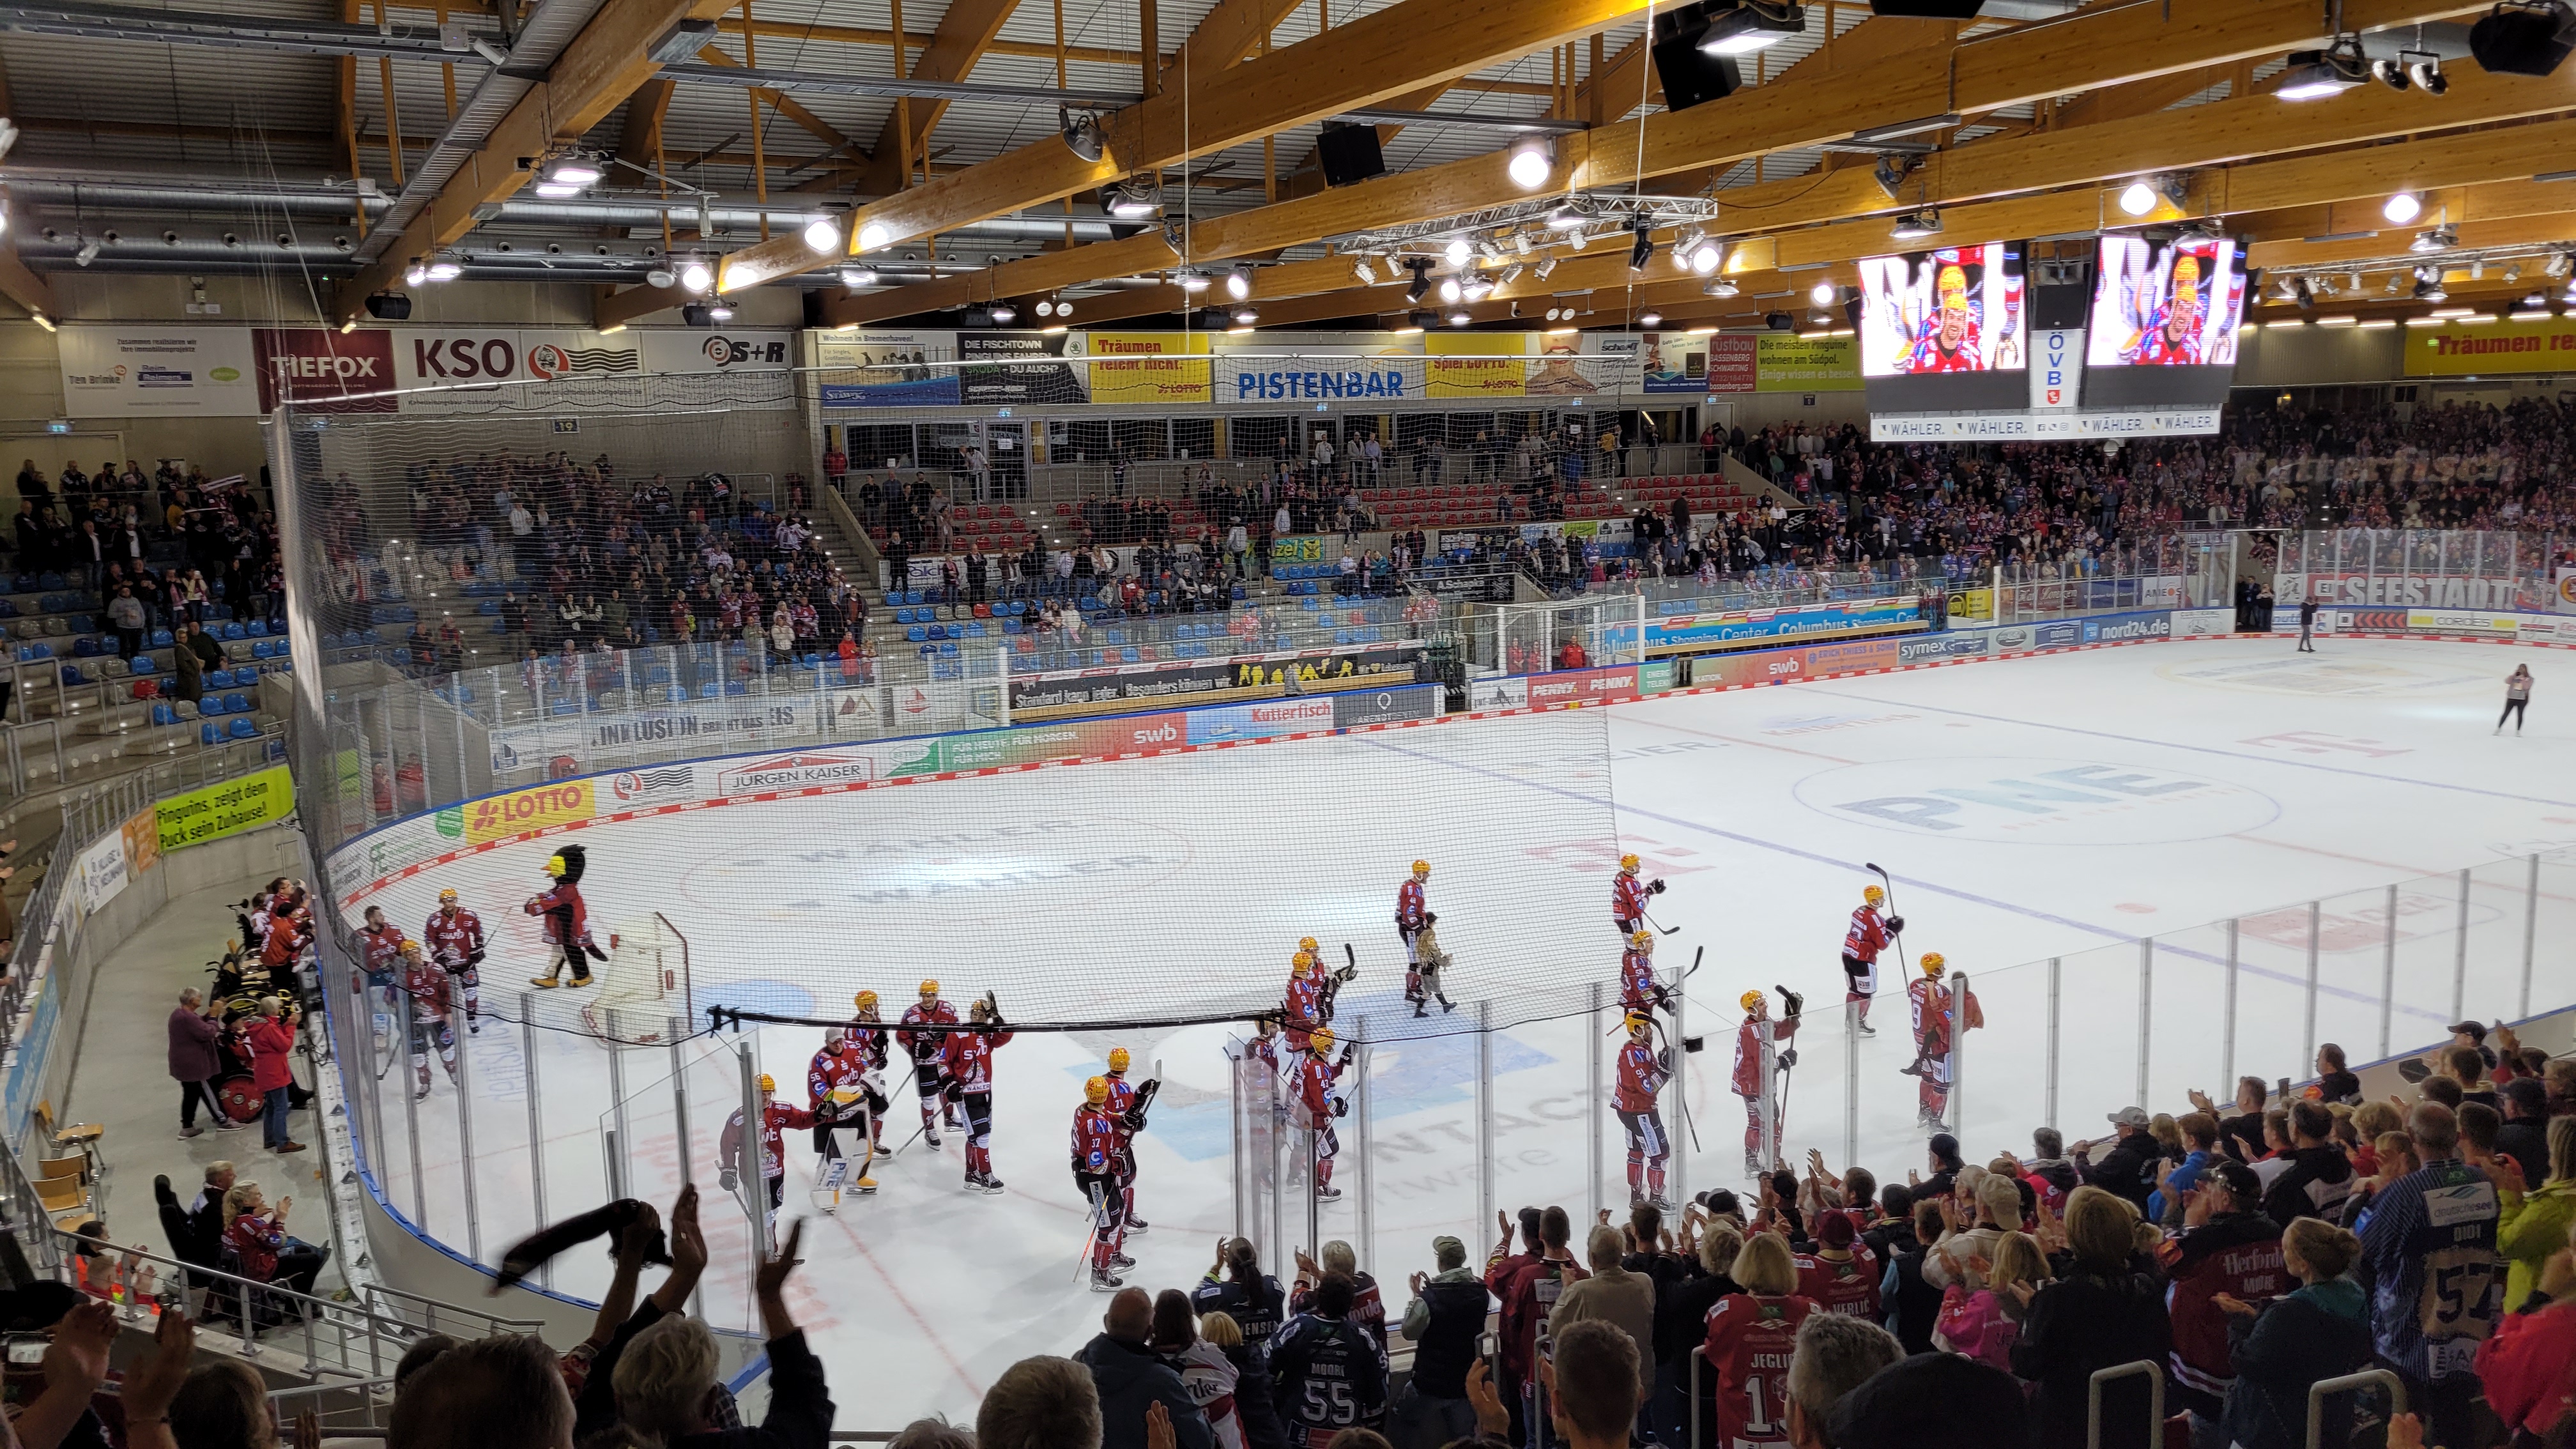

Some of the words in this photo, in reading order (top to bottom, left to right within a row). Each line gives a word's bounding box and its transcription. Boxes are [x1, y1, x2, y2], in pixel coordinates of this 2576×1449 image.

[731, 341, 785, 362] S+R
[964, 340, 981, 349] DIE
[983, 340, 1043, 349] FISCHTOWN
[1098, 339, 1162, 353] Träumen
[1760, 340, 1775, 350] Die
[1776, 340, 1809, 350] meisten
[2436, 334, 2540, 355] Träumen
[2550, 334, 2576, 350] re
[270, 356, 377, 378] TIEFOX
[414, 339, 515, 378] KSO
[1760, 355, 1792, 365] wohnen
[1809, 355, 1839, 366] Südpol.
[2046, 332, 2064, 386] ÖVB
[1009, 365, 1024, 373] DU
[1025, 365, 1059, 374] AUCH?
[1760, 369, 1786, 381] Einige
[1788, 370, 1815, 379] wissen
[1171, 384, 1202, 394] LOTTO
[1238, 371, 1404, 399] PISTENBAR
[558, 421, 574, 431] 19
[1779, 619, 1847, 634] Columbus
[2101, 618, 2170, 640] nord24.de
[2437, 617, 2490, 627] CORDES
[1721, 627, 1768, 640] Center
[1901, 641, 1945, 659] symex
[1768, 657, 1799, 675] swb
[1252, 701, 1331, 723] Kutterfisch
[1133, 723, 1177, 744] swb
[953, 742, 972, 753] FÜR
[1013, 735, 1034, 746] FÜR
[954, 756, 972, 764] FÜR
[732, 772, 799, 788] JÜRGEN
[805, 765, 860, 780] KAISER
[504, 785, 582, 823] LOTTO
[1832, 765, 2213, 831] PNE
[189, 820, 215, 840] sein
[810, 1072, 821, 1082] 56
[1636, 1068, 1646, 1078] 91
[1115, 1098, 1125, 1109] 71
[1091, 1138, 1101, 1148] 37
[1301, 1378, 1356, 1425] 55
